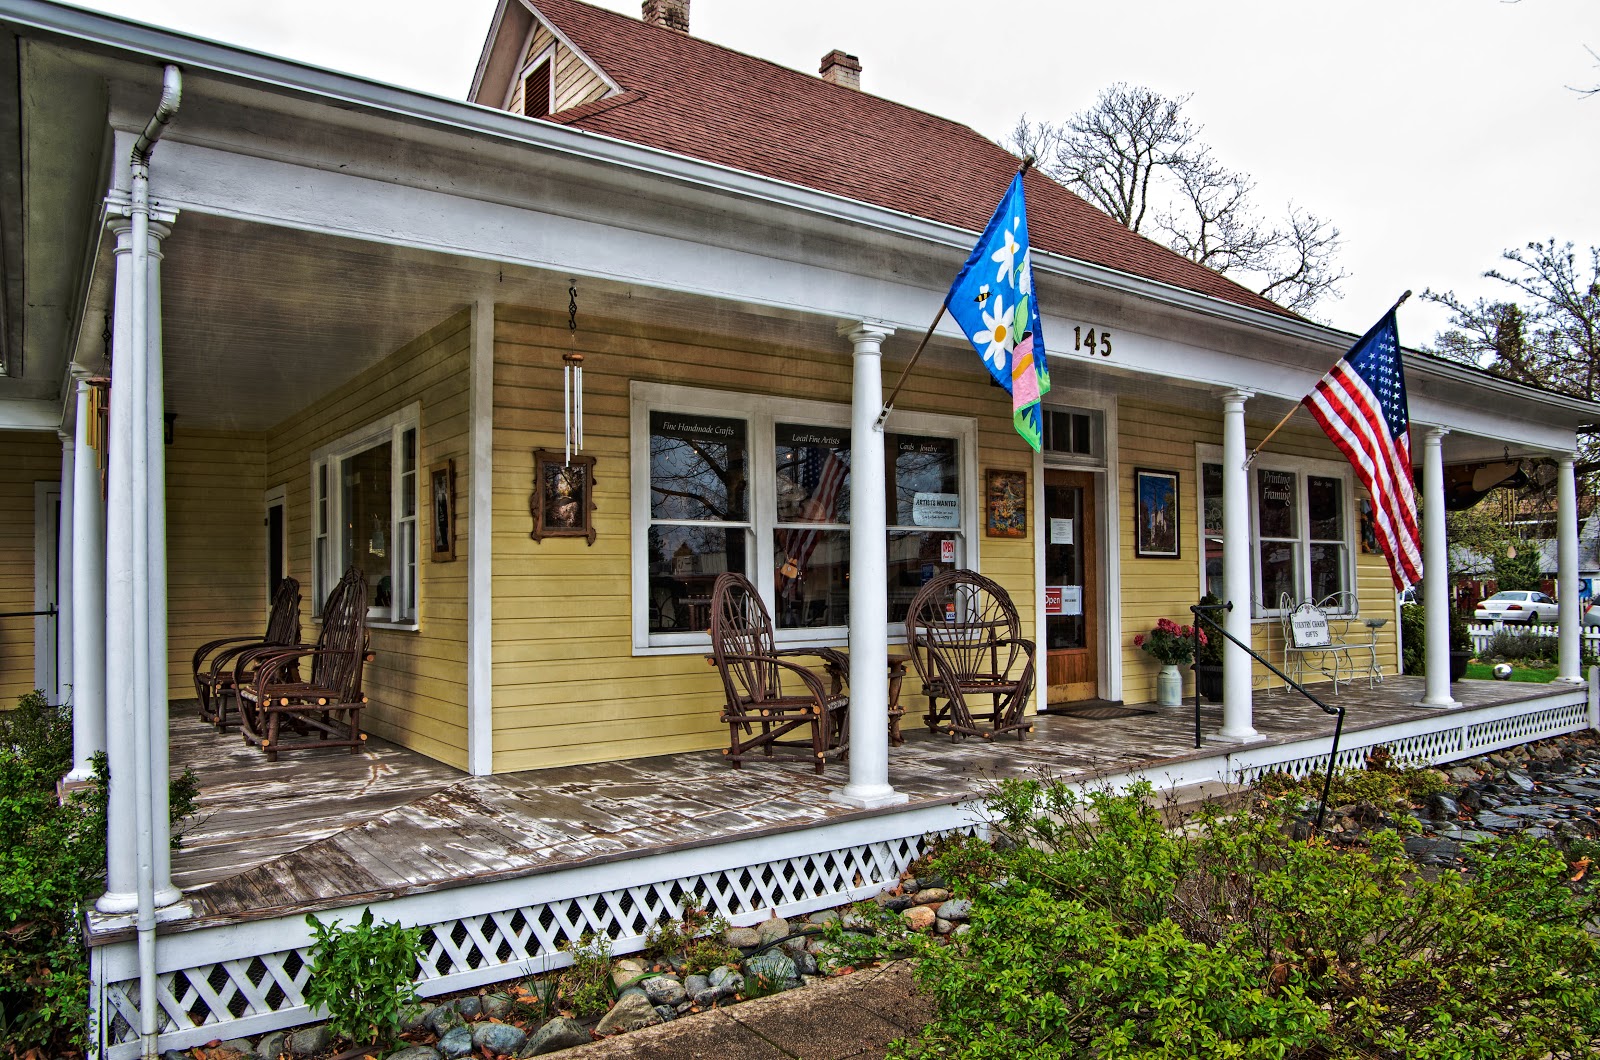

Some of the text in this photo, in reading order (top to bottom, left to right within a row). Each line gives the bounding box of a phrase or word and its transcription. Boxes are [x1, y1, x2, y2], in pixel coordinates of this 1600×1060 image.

[1074, 326, 1112, 357] 145
[662, 421, 735, 437] Fine Handmade Crafts
[792, 433, 840, 445] Local Fine Artists
[1263, 470, 1291, 491] Printing
[915, 499, 936, 507] ARTISTS
[1263, 487, 1291, 507] Framing
[943, 541, 954, 553] OPEN
[1045, 594, 1061, 606] Open
